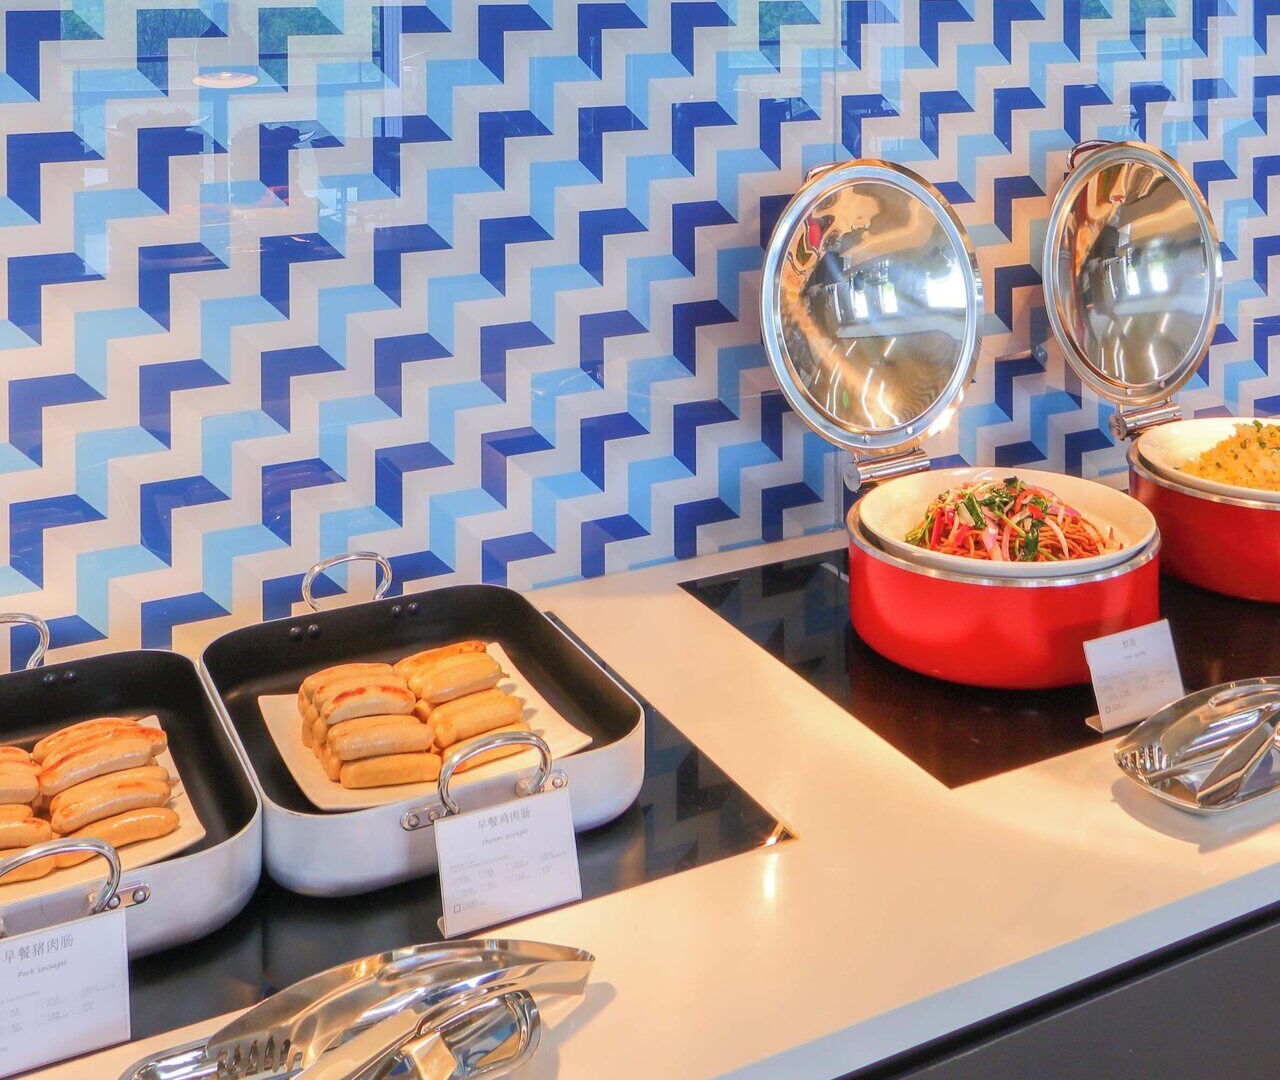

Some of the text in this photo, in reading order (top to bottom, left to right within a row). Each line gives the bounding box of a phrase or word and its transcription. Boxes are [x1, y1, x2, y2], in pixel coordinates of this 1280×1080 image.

[2, 933, 74, 964] 早餐猪肉肠
[17, 969, 35, 980] Pork
